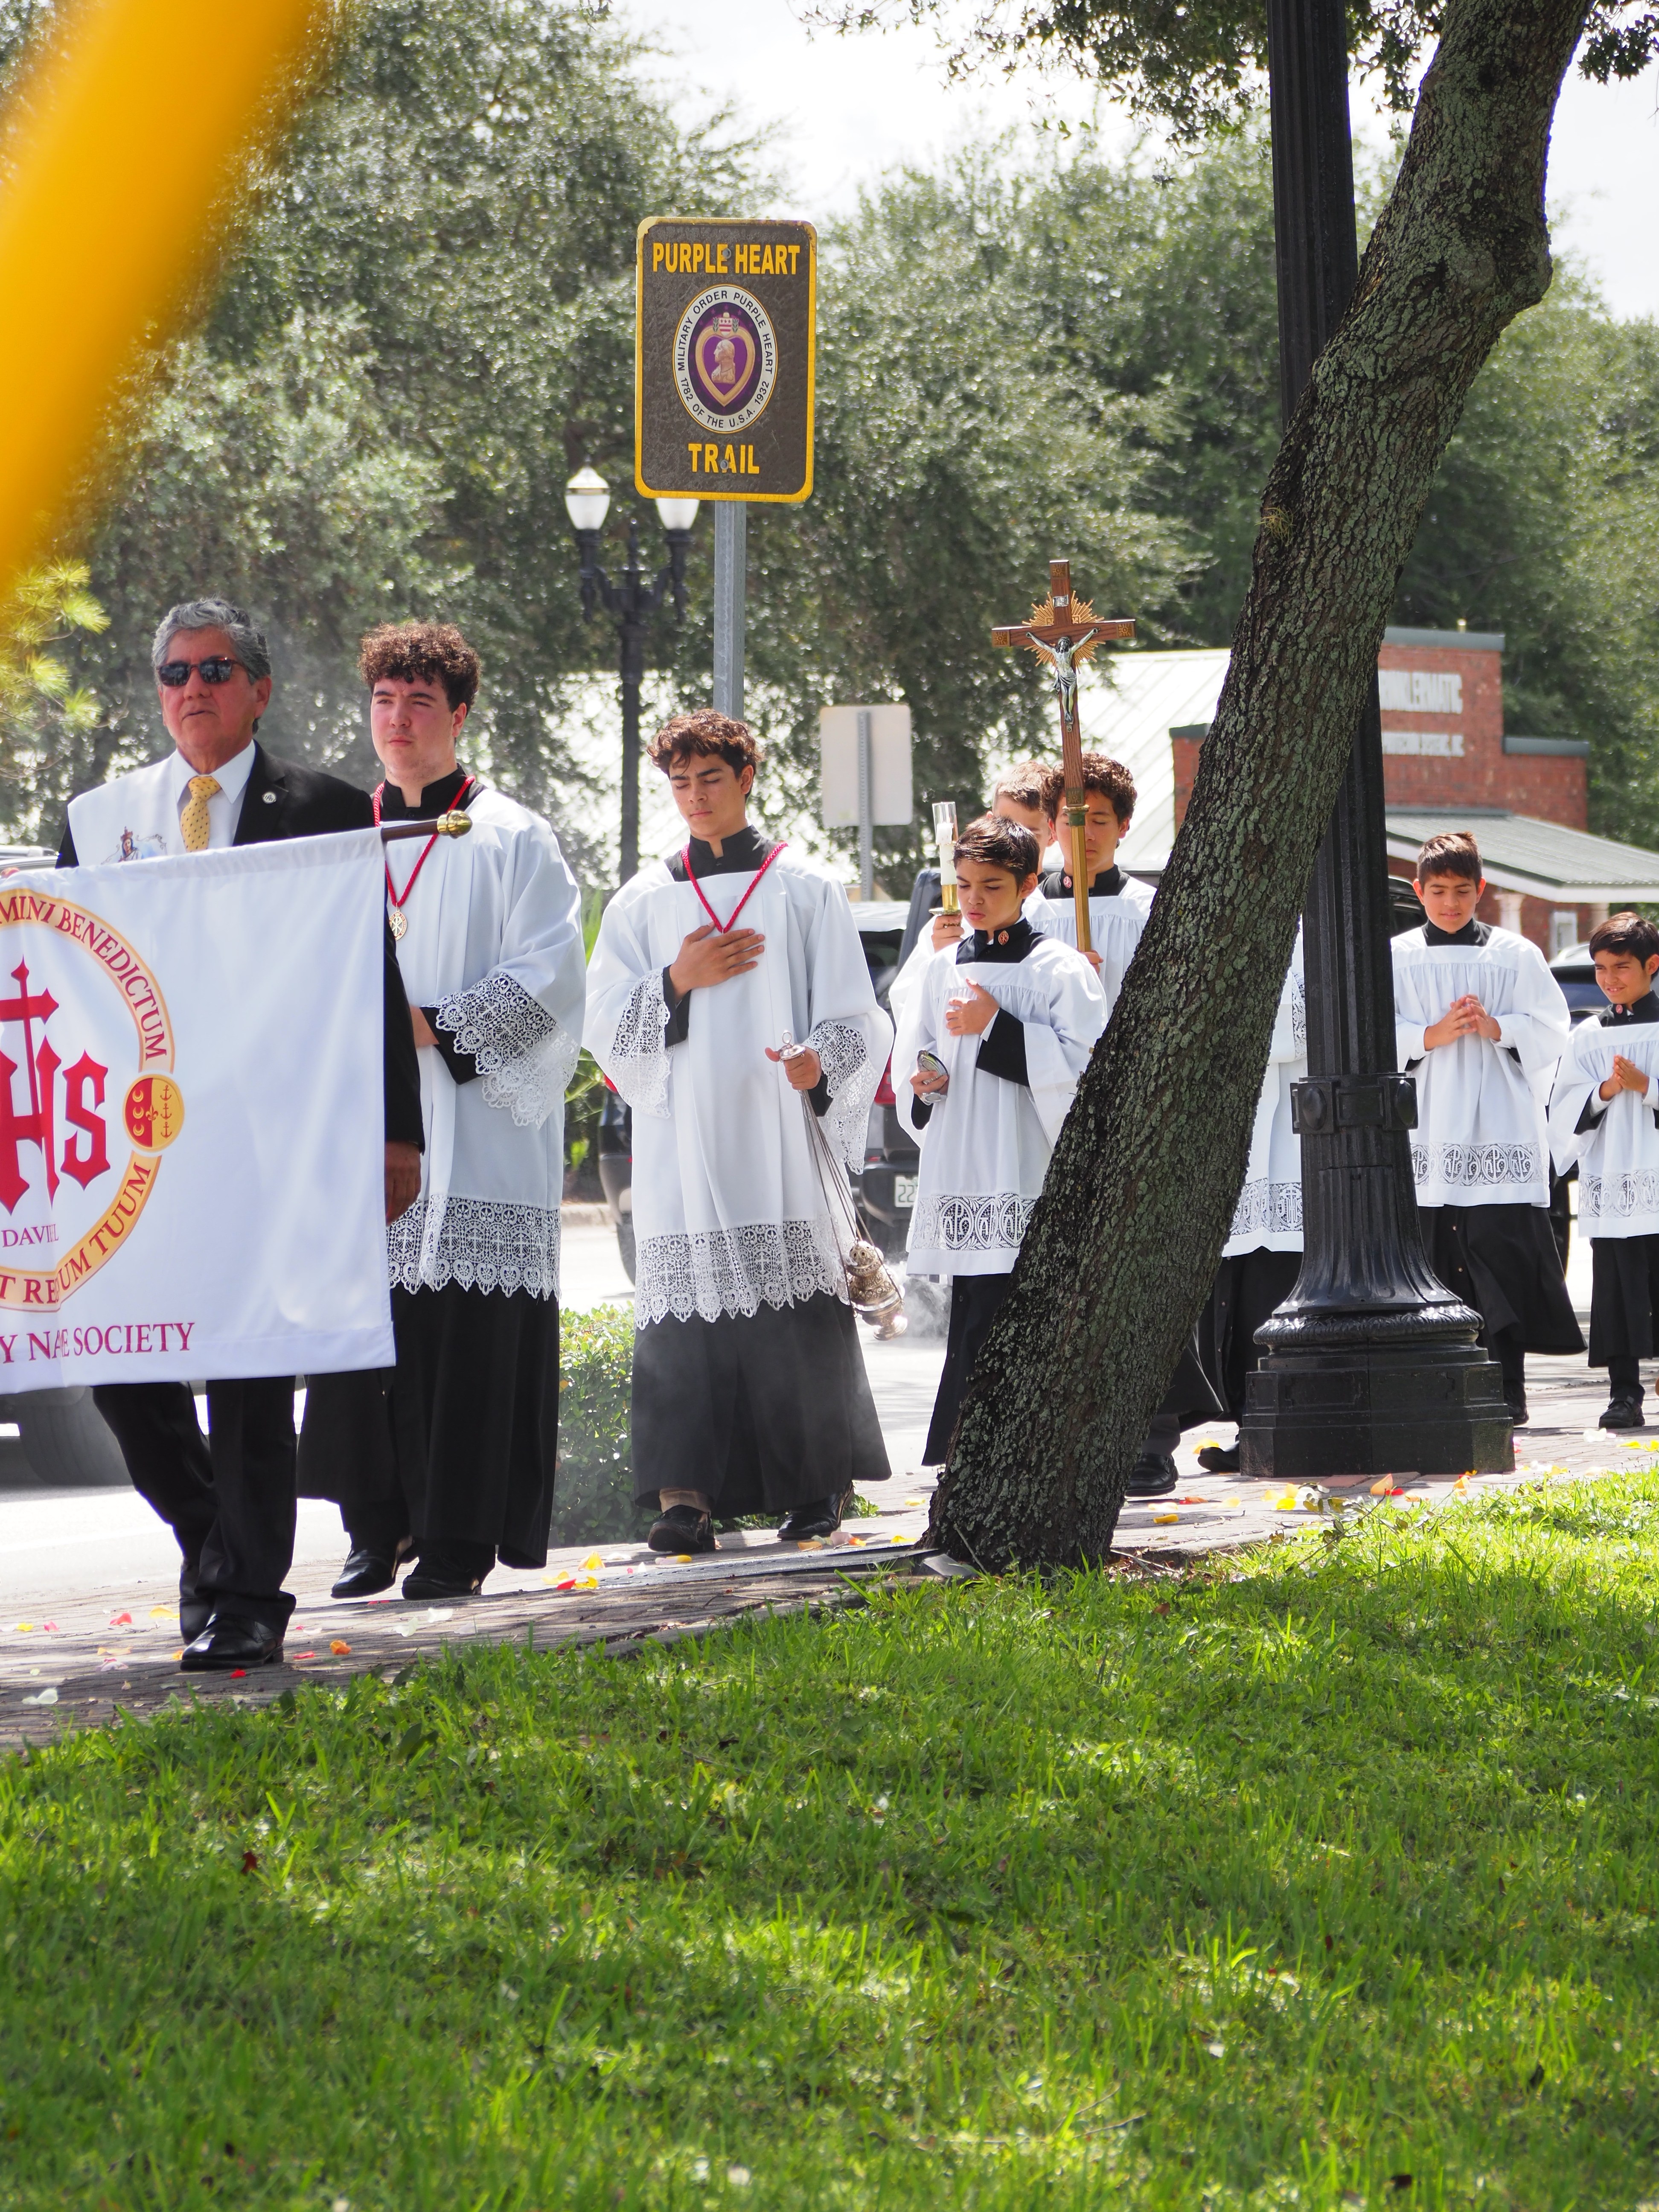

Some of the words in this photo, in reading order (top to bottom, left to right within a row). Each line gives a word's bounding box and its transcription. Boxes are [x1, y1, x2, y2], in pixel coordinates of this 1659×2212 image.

[653, 243, 728, 274] PURPLE
[735, 244, 800, 275] HEART
[677, 317, 693, 371] MILITARY
[693, 291, 728, 314] ORDER
[733, 292, 766, 329] PURPLE
[763, 333, 773, 374] HEART
[681, 377, 693, 402] 1782
[692, 404, 704, 416] OF
[707, 415, 724, 428] THE
[729, 409, 755, 427] U.S.A.
[754, 381, 769, 405] 1932
[688, 443, 760, 474] TRAIL
[55, 907, 167, 1061] BENEDICTUM
[89, 1161, 151, 1255] TUUM
[73, 1322, 195, 1356] SOCIETY
